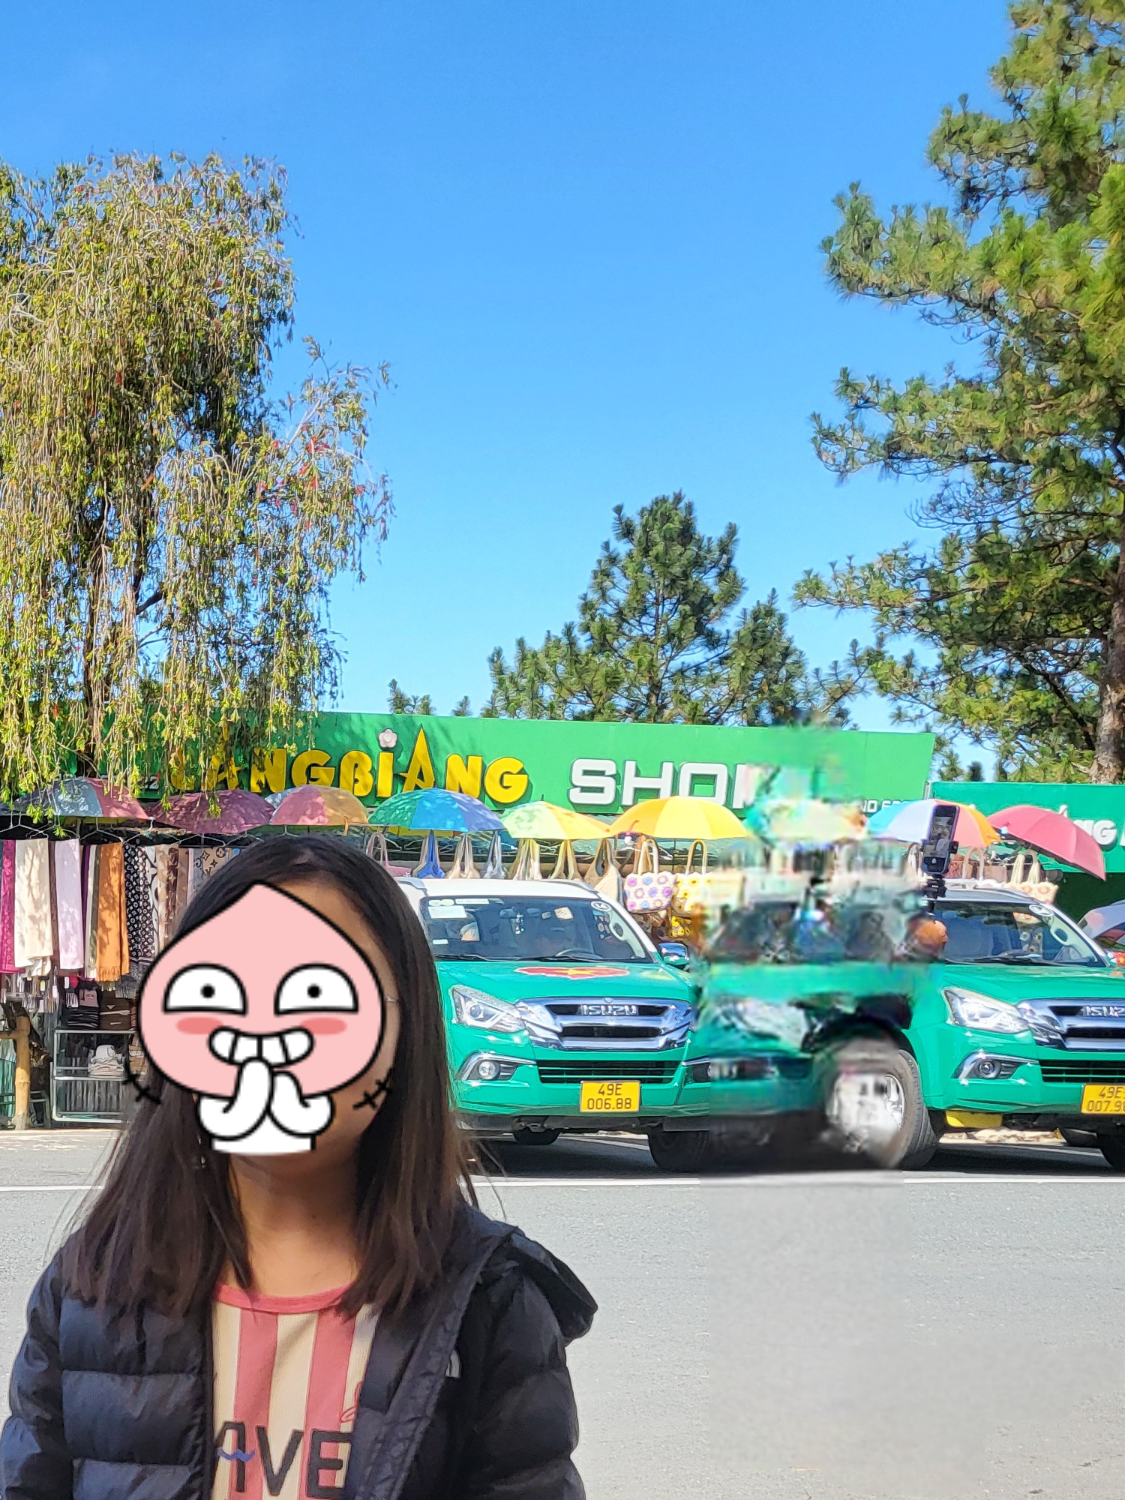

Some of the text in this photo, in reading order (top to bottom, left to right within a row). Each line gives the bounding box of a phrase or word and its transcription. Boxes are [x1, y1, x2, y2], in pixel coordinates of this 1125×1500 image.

[582, 1004, 638, 1015] ISUZU
[597, 1084, 623, 1096] 49E
[587, 1098, 632, 1110] 006.88
